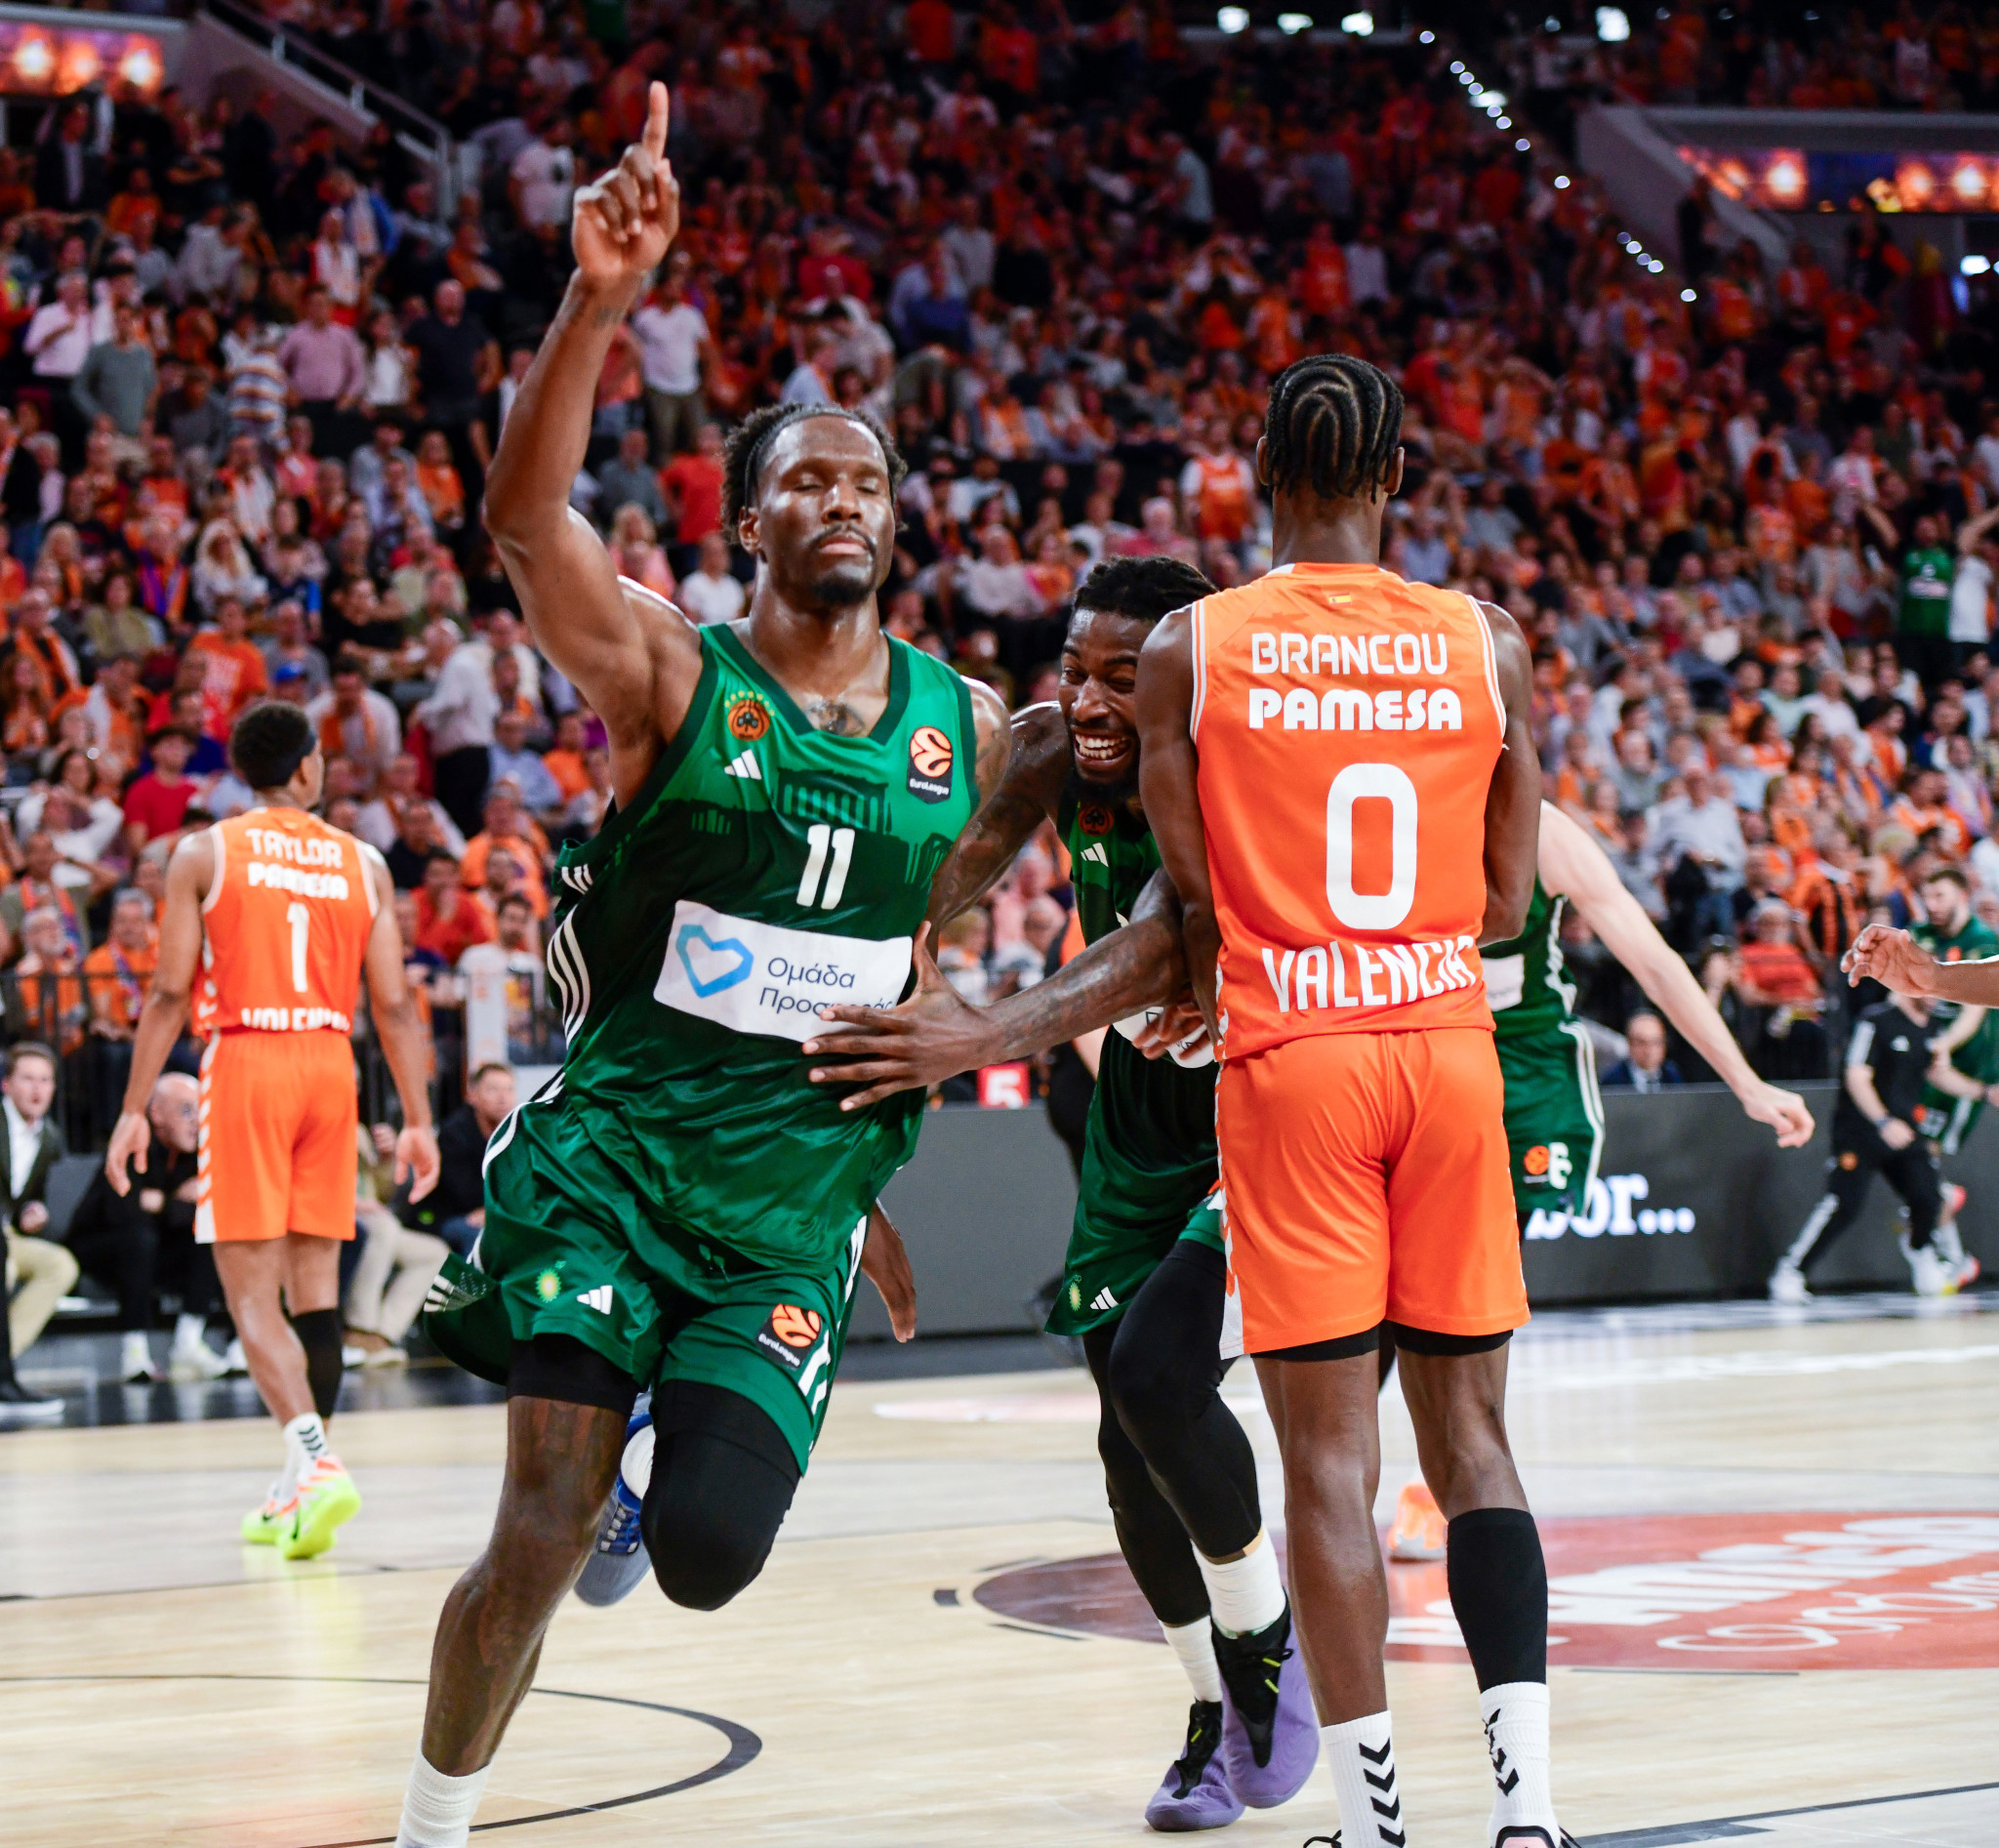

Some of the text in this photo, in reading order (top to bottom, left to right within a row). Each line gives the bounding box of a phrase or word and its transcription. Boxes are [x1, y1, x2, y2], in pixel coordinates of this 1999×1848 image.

[1251, 633, 1448, 675] BRANCOU
[1248, 688, 1462, 730] PAMESA
[246, 828, 343, 869] TAYLOR
[796, 823, 856, 910] 11
[1326, 762, 1418, 930] 0
[247, 861, 349, 900] PAMESA
[286, 902, 310, 993] 1
[767, 957, 856, 989] Ομάδα
[1261, 935, 1478, 1013] VALENCIA
